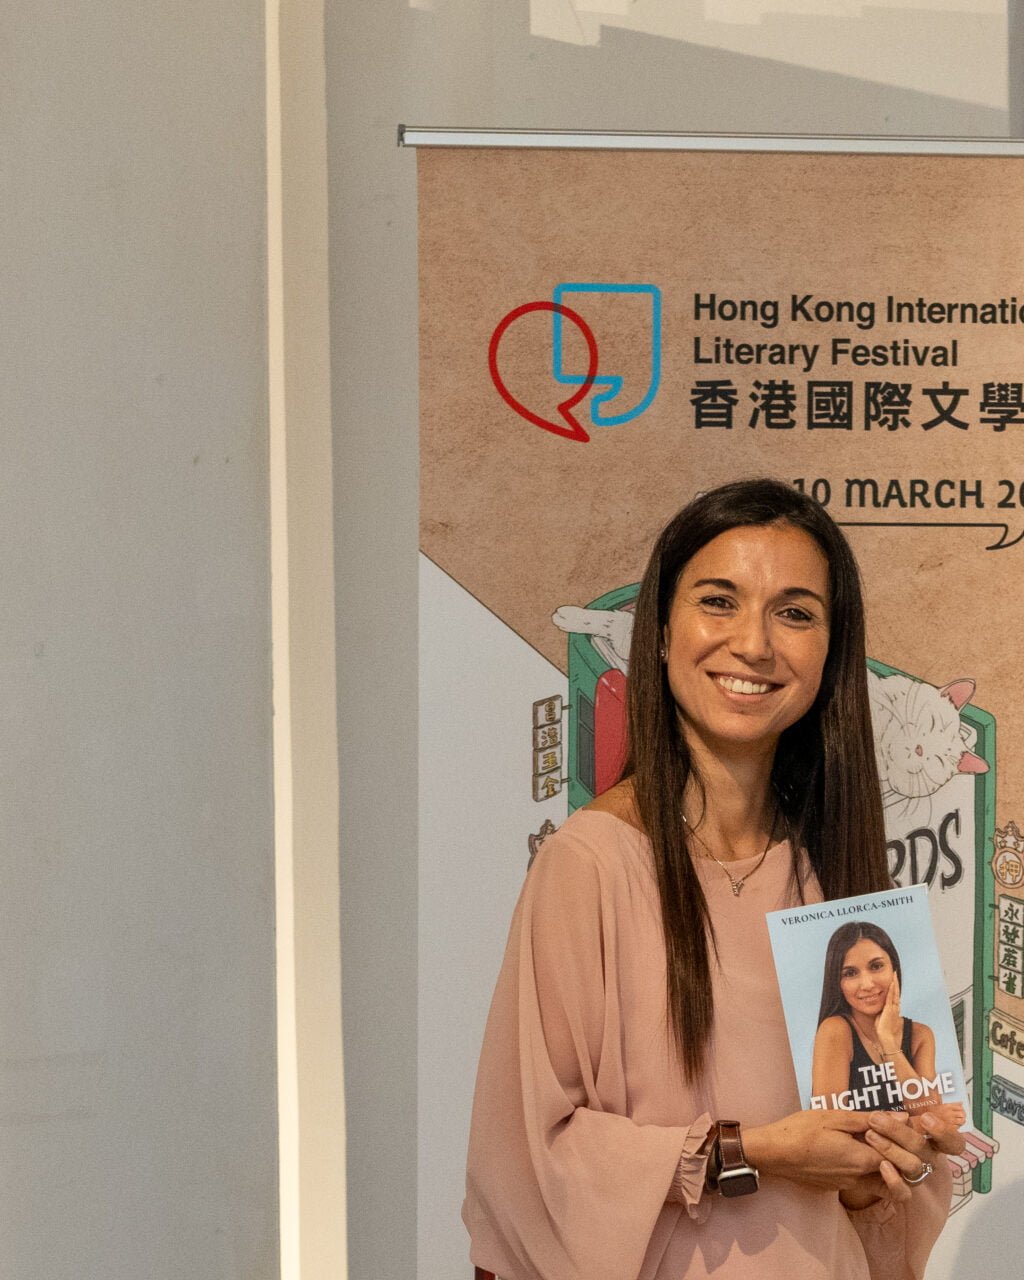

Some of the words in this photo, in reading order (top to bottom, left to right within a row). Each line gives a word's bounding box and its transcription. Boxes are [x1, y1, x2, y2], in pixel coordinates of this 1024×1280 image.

[694, 293, 779, 328] Hong
[791, 294, 875, 330] Kong
[694, 336, 819, 372] Literary
[832, 338, 958, 366] Festival
[845, 478, 984, 509] MARCH
[781, 910, 834, 926] VERONICA
[836, 895, 914, 916] LLORCA-SMITH
[858, 1061, 898, 1085] THE
[886, 1072, 955, 1104] HOME
[909, 1099, 938, 1110] LESSONS
